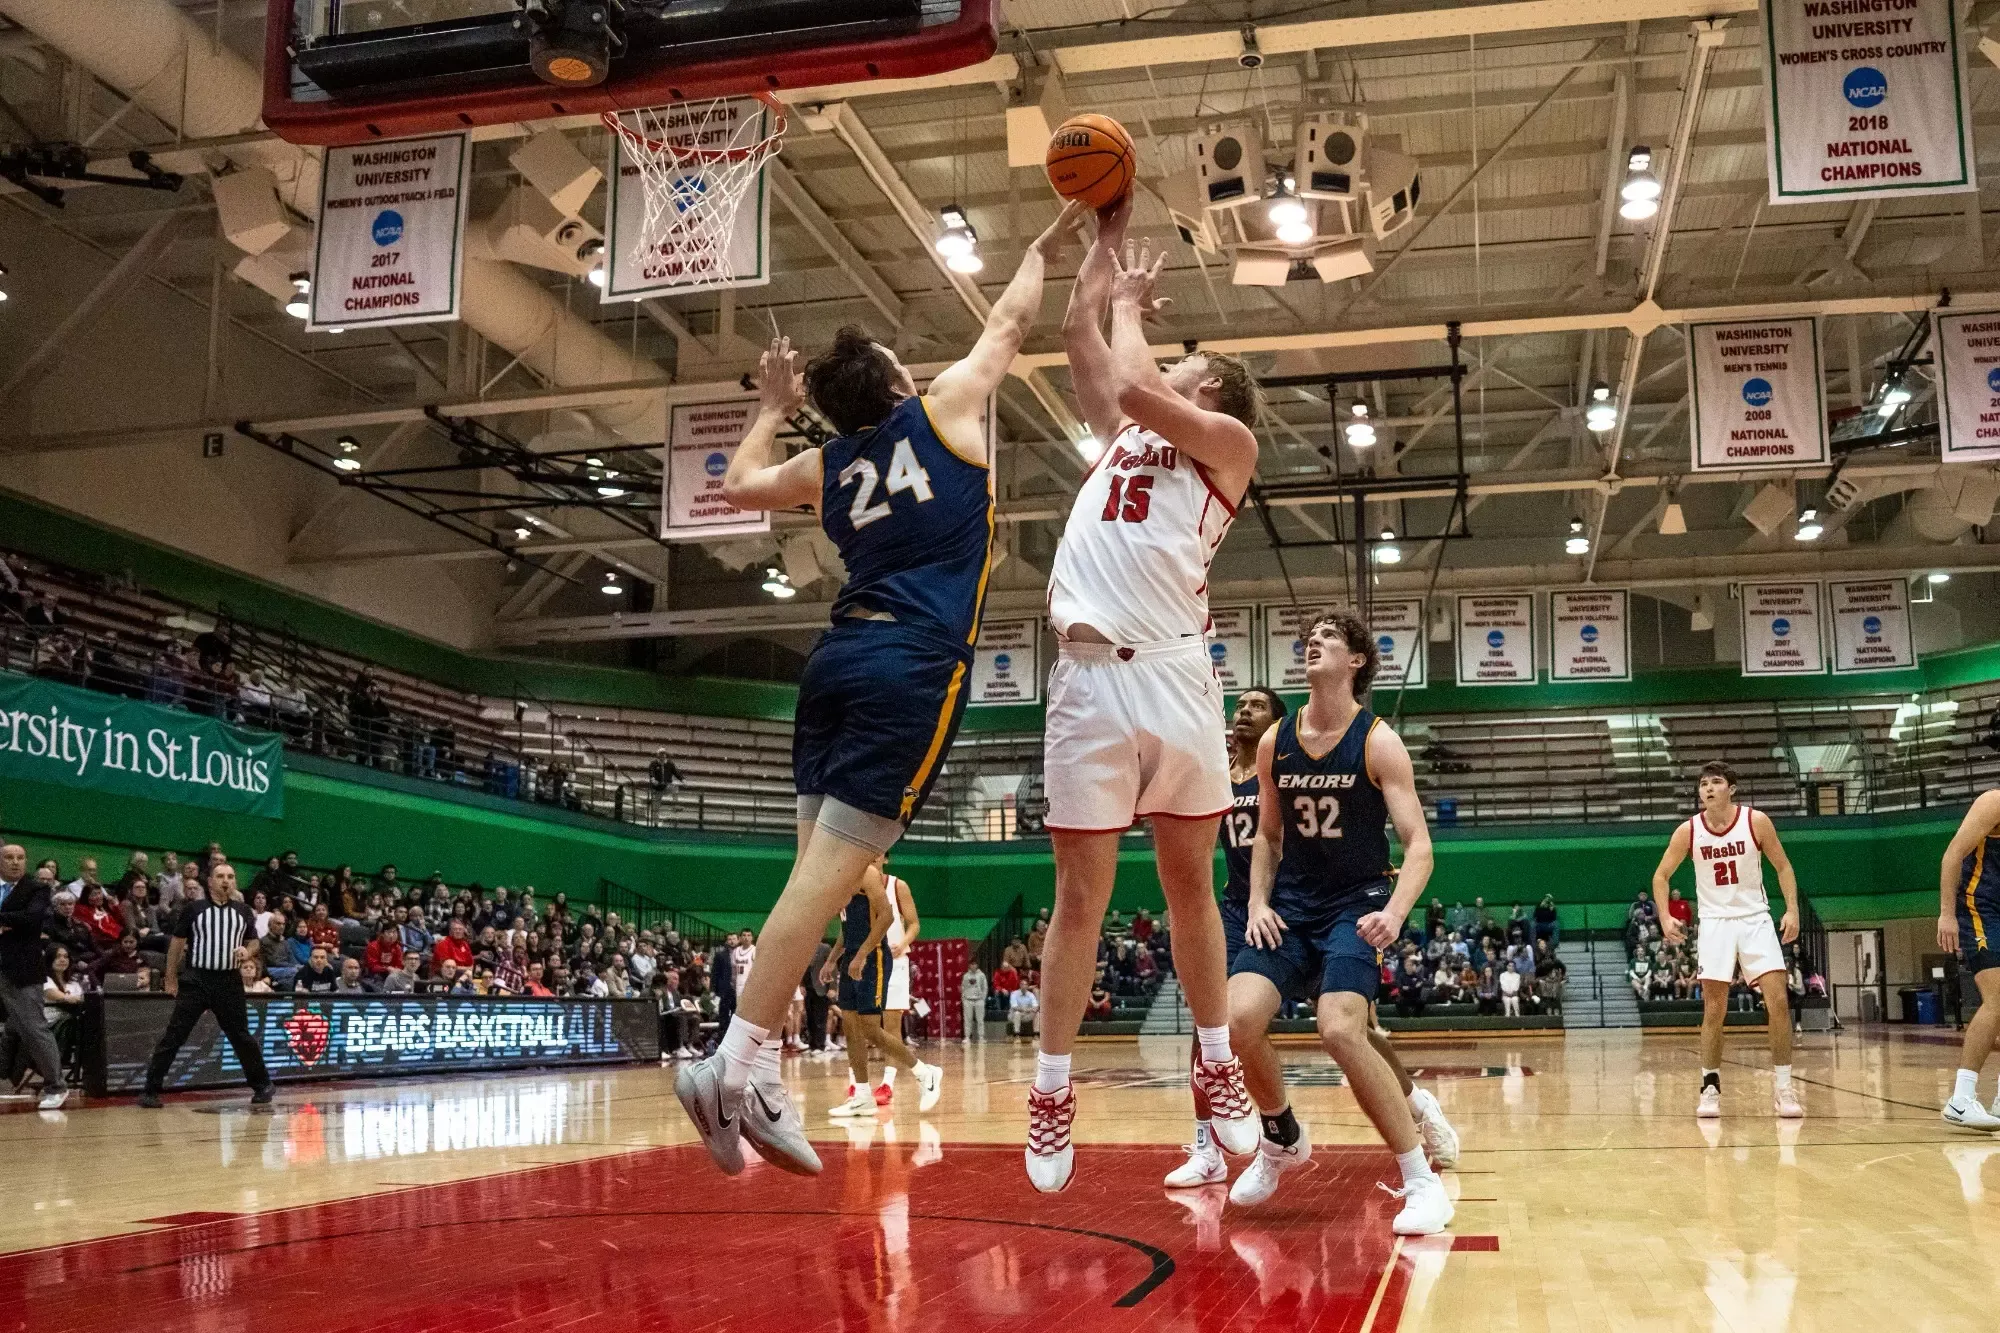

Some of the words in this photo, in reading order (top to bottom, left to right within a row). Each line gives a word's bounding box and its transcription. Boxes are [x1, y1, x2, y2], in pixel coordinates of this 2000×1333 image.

[1804, 0, 1918, 18] WASHINGTON
[1812, 17, 1914, 40] UNIVERSITY
[1779, 49, 1838, 66] WOMEN'S
[1842, 46, 1884, 61] CROSS
[1887, 41, 1947, 57] COUNTRY
[1849, 86, 1885, 99] NCAA
[646, 107, 738, 133] WASHINGTON
[1849, 115, 1889, 131] 2018
[1827, 139, 1912, 158] NATIONAL
[351, 147, 437, 167] WASHINGTON
[355, 168, 431, 187] UNIVERSITY
[1821, 162, 1922, 182] CHAMPIONS
[327, 197, 363, 210] WOMEN'S
[364, 193, 400, 207] OUTDOOR
[400, 190, 425, 203] TRACK
[433, 187, 455, 199] FIELD
[371, 252, 401, 268] 2017
[352, 272, 415, 291] NATIONAL
[344, 292, 420, 312] CHAMPIONS
[1716, 327, 1792, 341] WASHINGTON
[1720, 343, 1789, 357] UNIVERSITY
[1724, 363, 1752, 374] MEN'S
[1754, 361, 1788, 372] TENNIS
[688, 409, 748, 423] WASHINGTON
[1745, 410, 1772, 422] 2008
[691, 423, 744, 436] UNIVERSITY
[1731, 428, 1788, 441] NATIONAL
[1726, 444, 1795, 458] CHAMPIONS
[837, 436, 934, 531] 24
[1101, 474, 1154, 523] 15
[1757, 588, 1804, 596] WASHINGTON
[1845, 584, 1893, 593] WASHINGTON
[1760, 598, 1801, 606] UNIVERSITY
[1848, 594, 1891, 604] UNIVERSITY
[1765, 650, 1801, 658] NATIONAL
[1856, 646, 1891, 654] NATIONAL
[1573, 655, 1607, 664] NATIONAL
[1763, 660, 1804, 668] CHAMPIONS
[1854, 656, 1896, 665] CHAMPIONS
[1570, 666, 1611, 674] CHAMPIONS
[102, 716, 142, 773] in
[1278, 774, 1357, 789] EMORY
[1293, 795, 1343, 839] 32
[1225, 812, 1254, 848] 12
[1700, 840, 1746, 861] WashU
[1713, 860, 1739, 886] 21
[346, 1014, 431, 1052] BEARS
[434, 1014, 568, 1049] BASKETBALL
